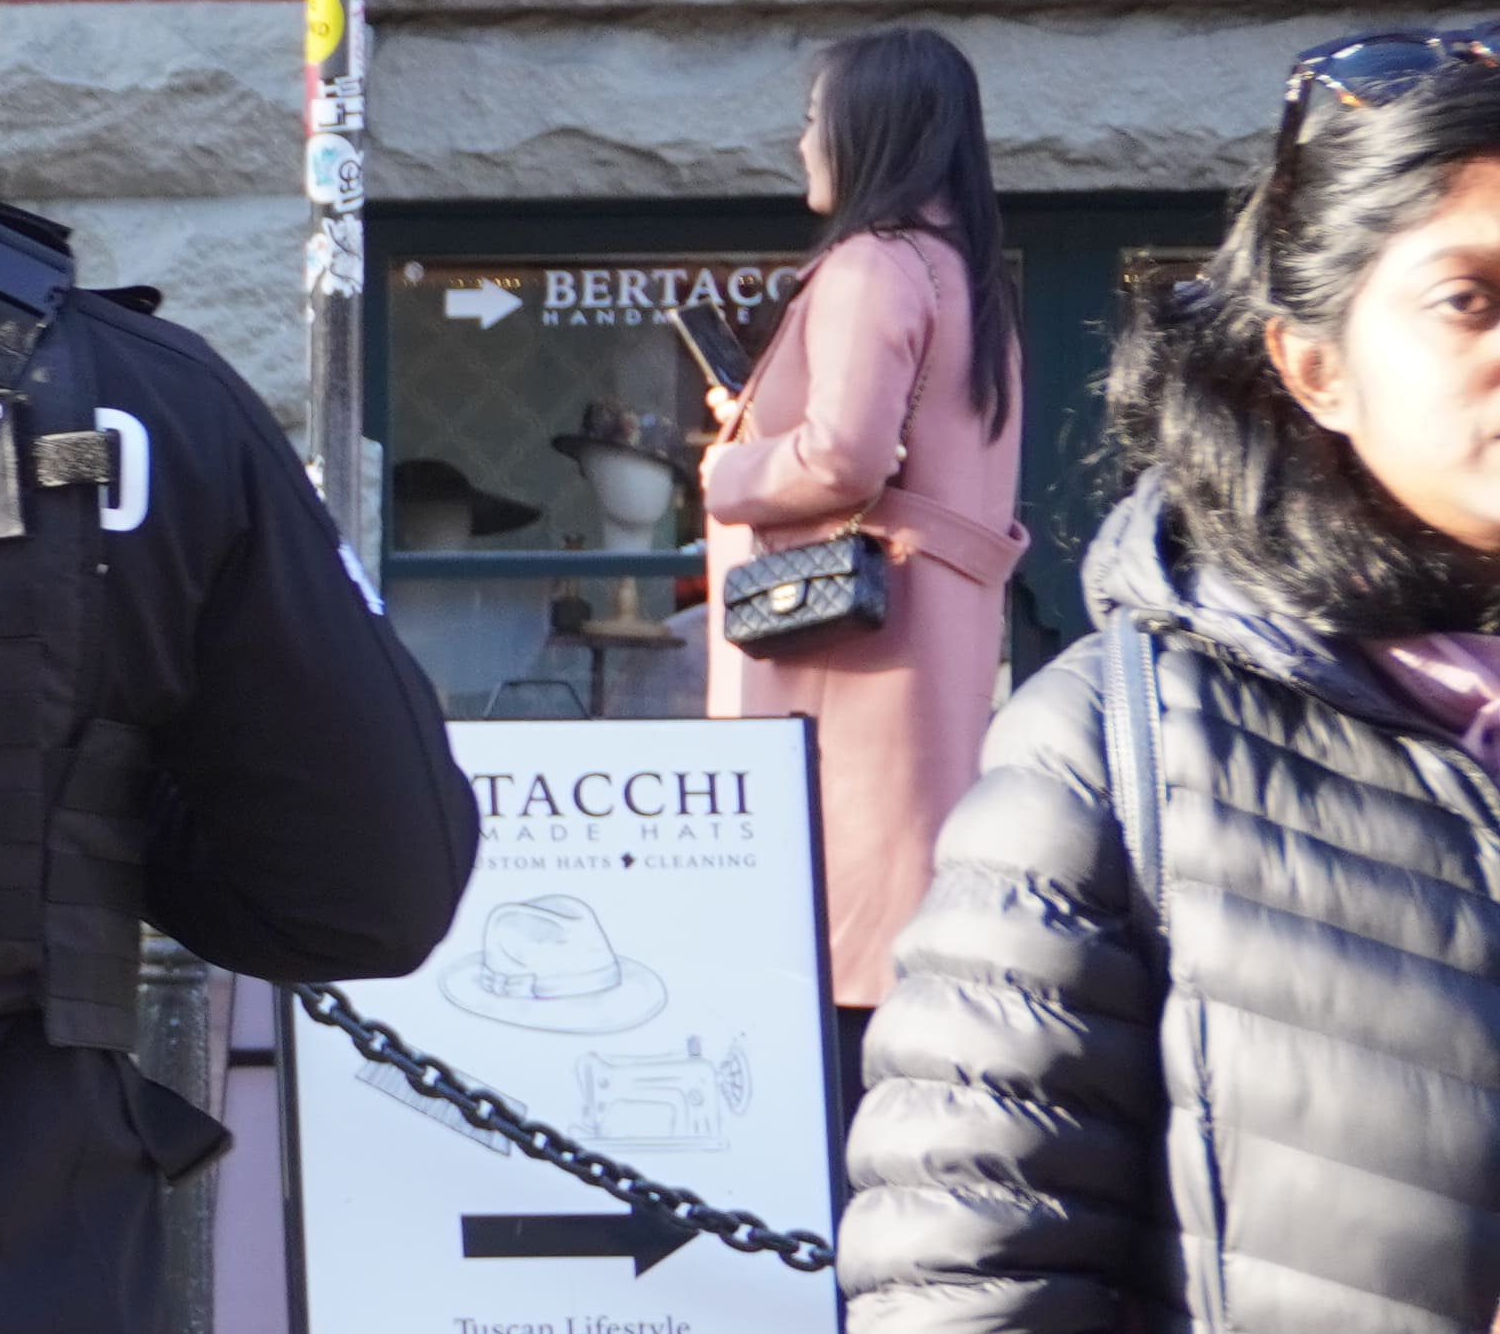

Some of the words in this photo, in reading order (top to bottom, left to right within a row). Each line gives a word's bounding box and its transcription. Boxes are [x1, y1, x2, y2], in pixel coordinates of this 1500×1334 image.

[640, 821, 754, 841] HATS
[556, 855, 612, 870] HATS
[643, 853, 757, 869] CLEANING
